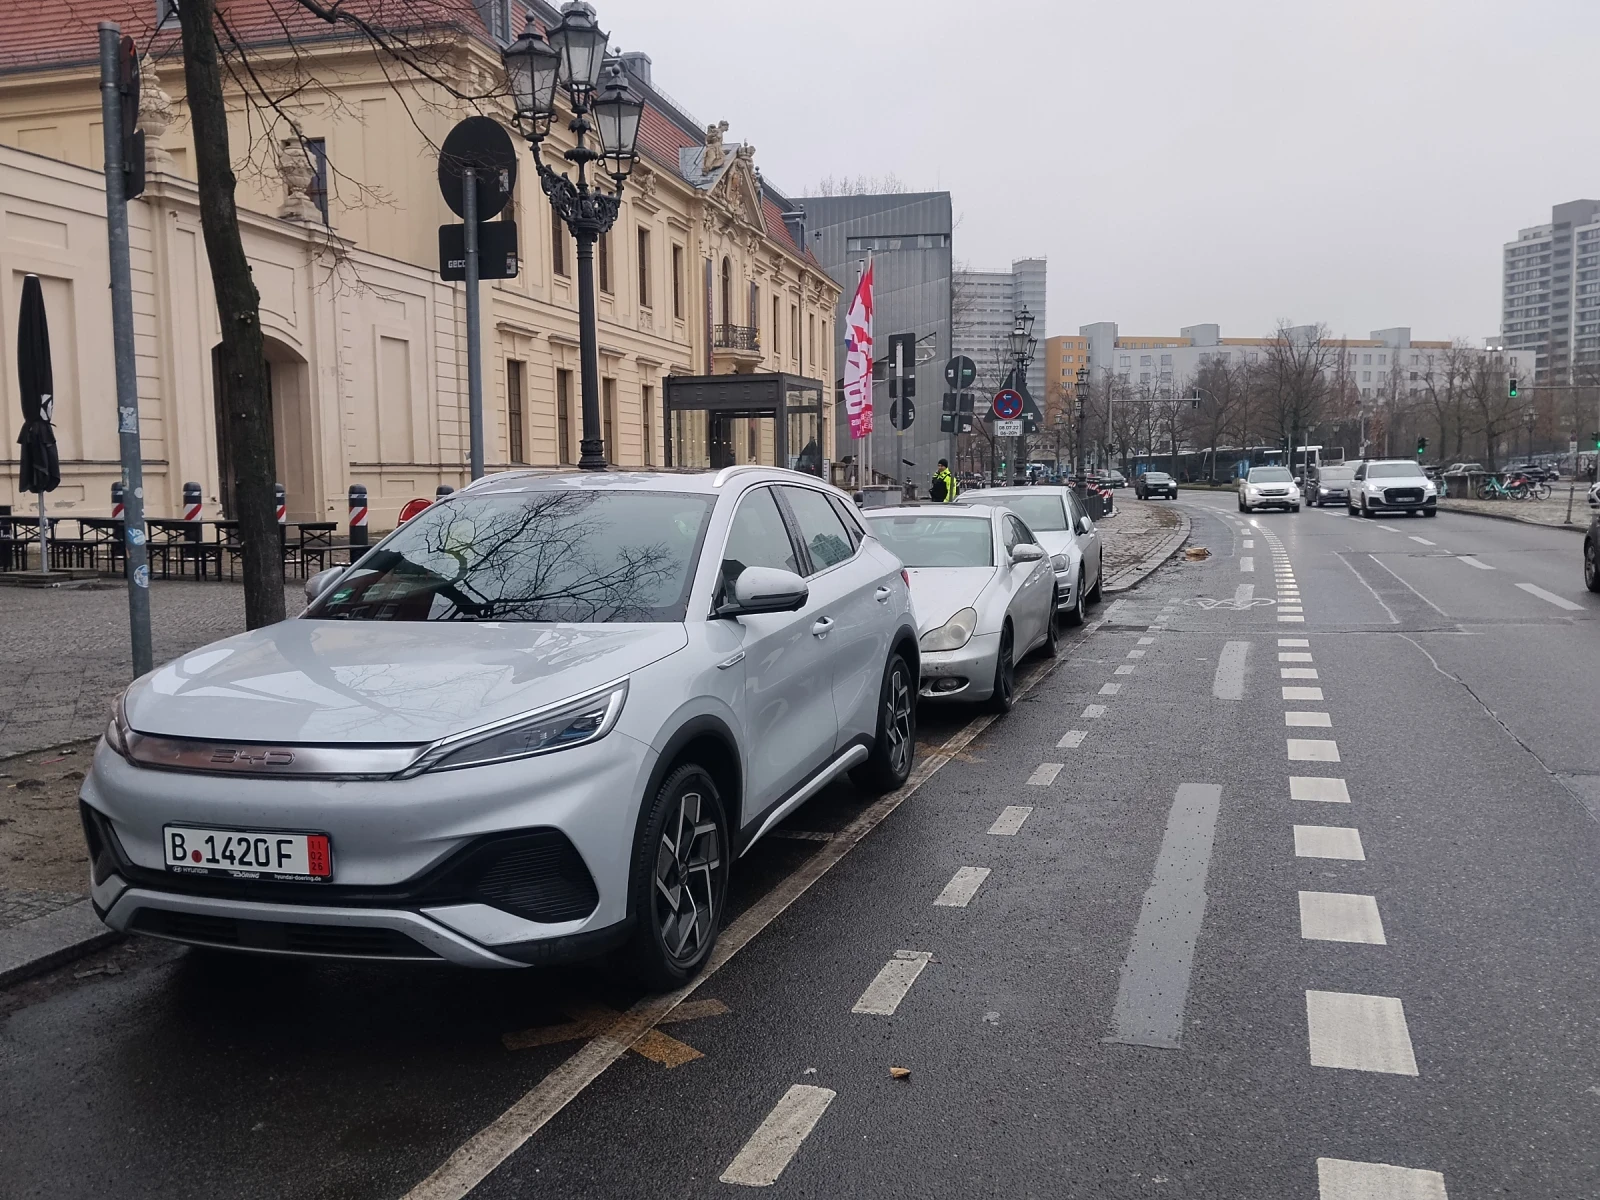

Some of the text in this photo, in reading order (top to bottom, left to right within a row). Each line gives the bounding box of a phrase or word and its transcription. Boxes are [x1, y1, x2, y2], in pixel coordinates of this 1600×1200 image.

[209, 748, 295, 766] BYD
[171, 832, 293, 868] B 1420 F
[311, 840, 321, 850] 11
[310, 851, 323, 860] 02
[311, 861, 323, 871] 26
[274, 873, 322, 882] hyundai-doering.de
